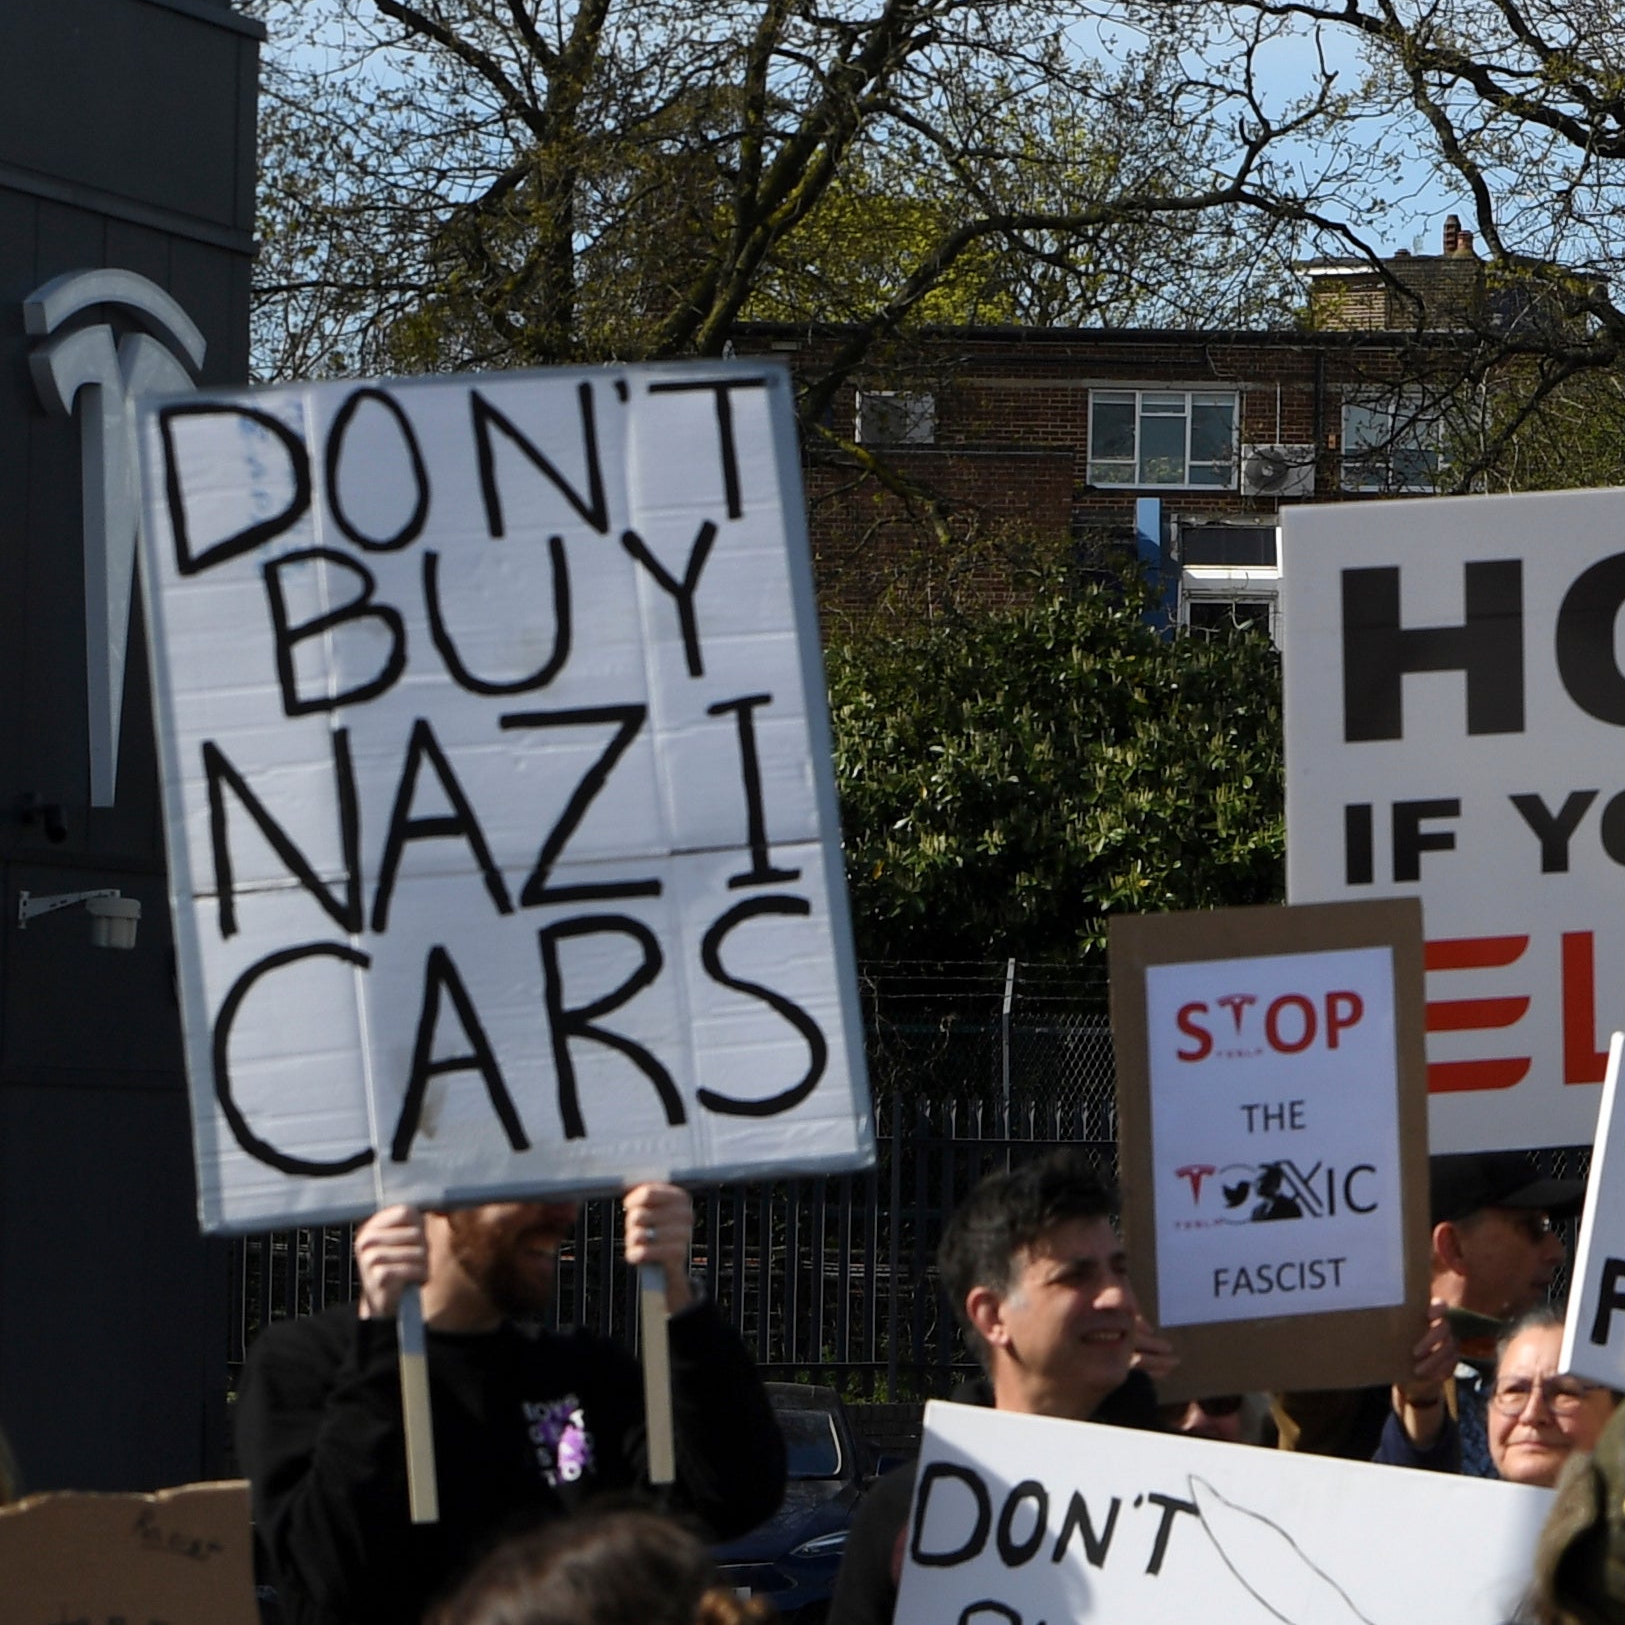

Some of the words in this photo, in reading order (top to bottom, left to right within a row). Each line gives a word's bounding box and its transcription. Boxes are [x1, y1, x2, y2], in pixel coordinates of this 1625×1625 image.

[160, 378, 772, 574] DON'T
[263, 520, 719, 718] BUY
[202, 693, 802, 938] NAZI
[1343, 797, 1462, 886] IF
[213, 894, 828, 1174] CARS
[1176, 990, 1365, 1064] STOP
[1241, 1100, 1307, 1133] THE
[1213, 1257, 1348, 1299] FASCIST
[911, 1462, 1200, 1576] DON'T
